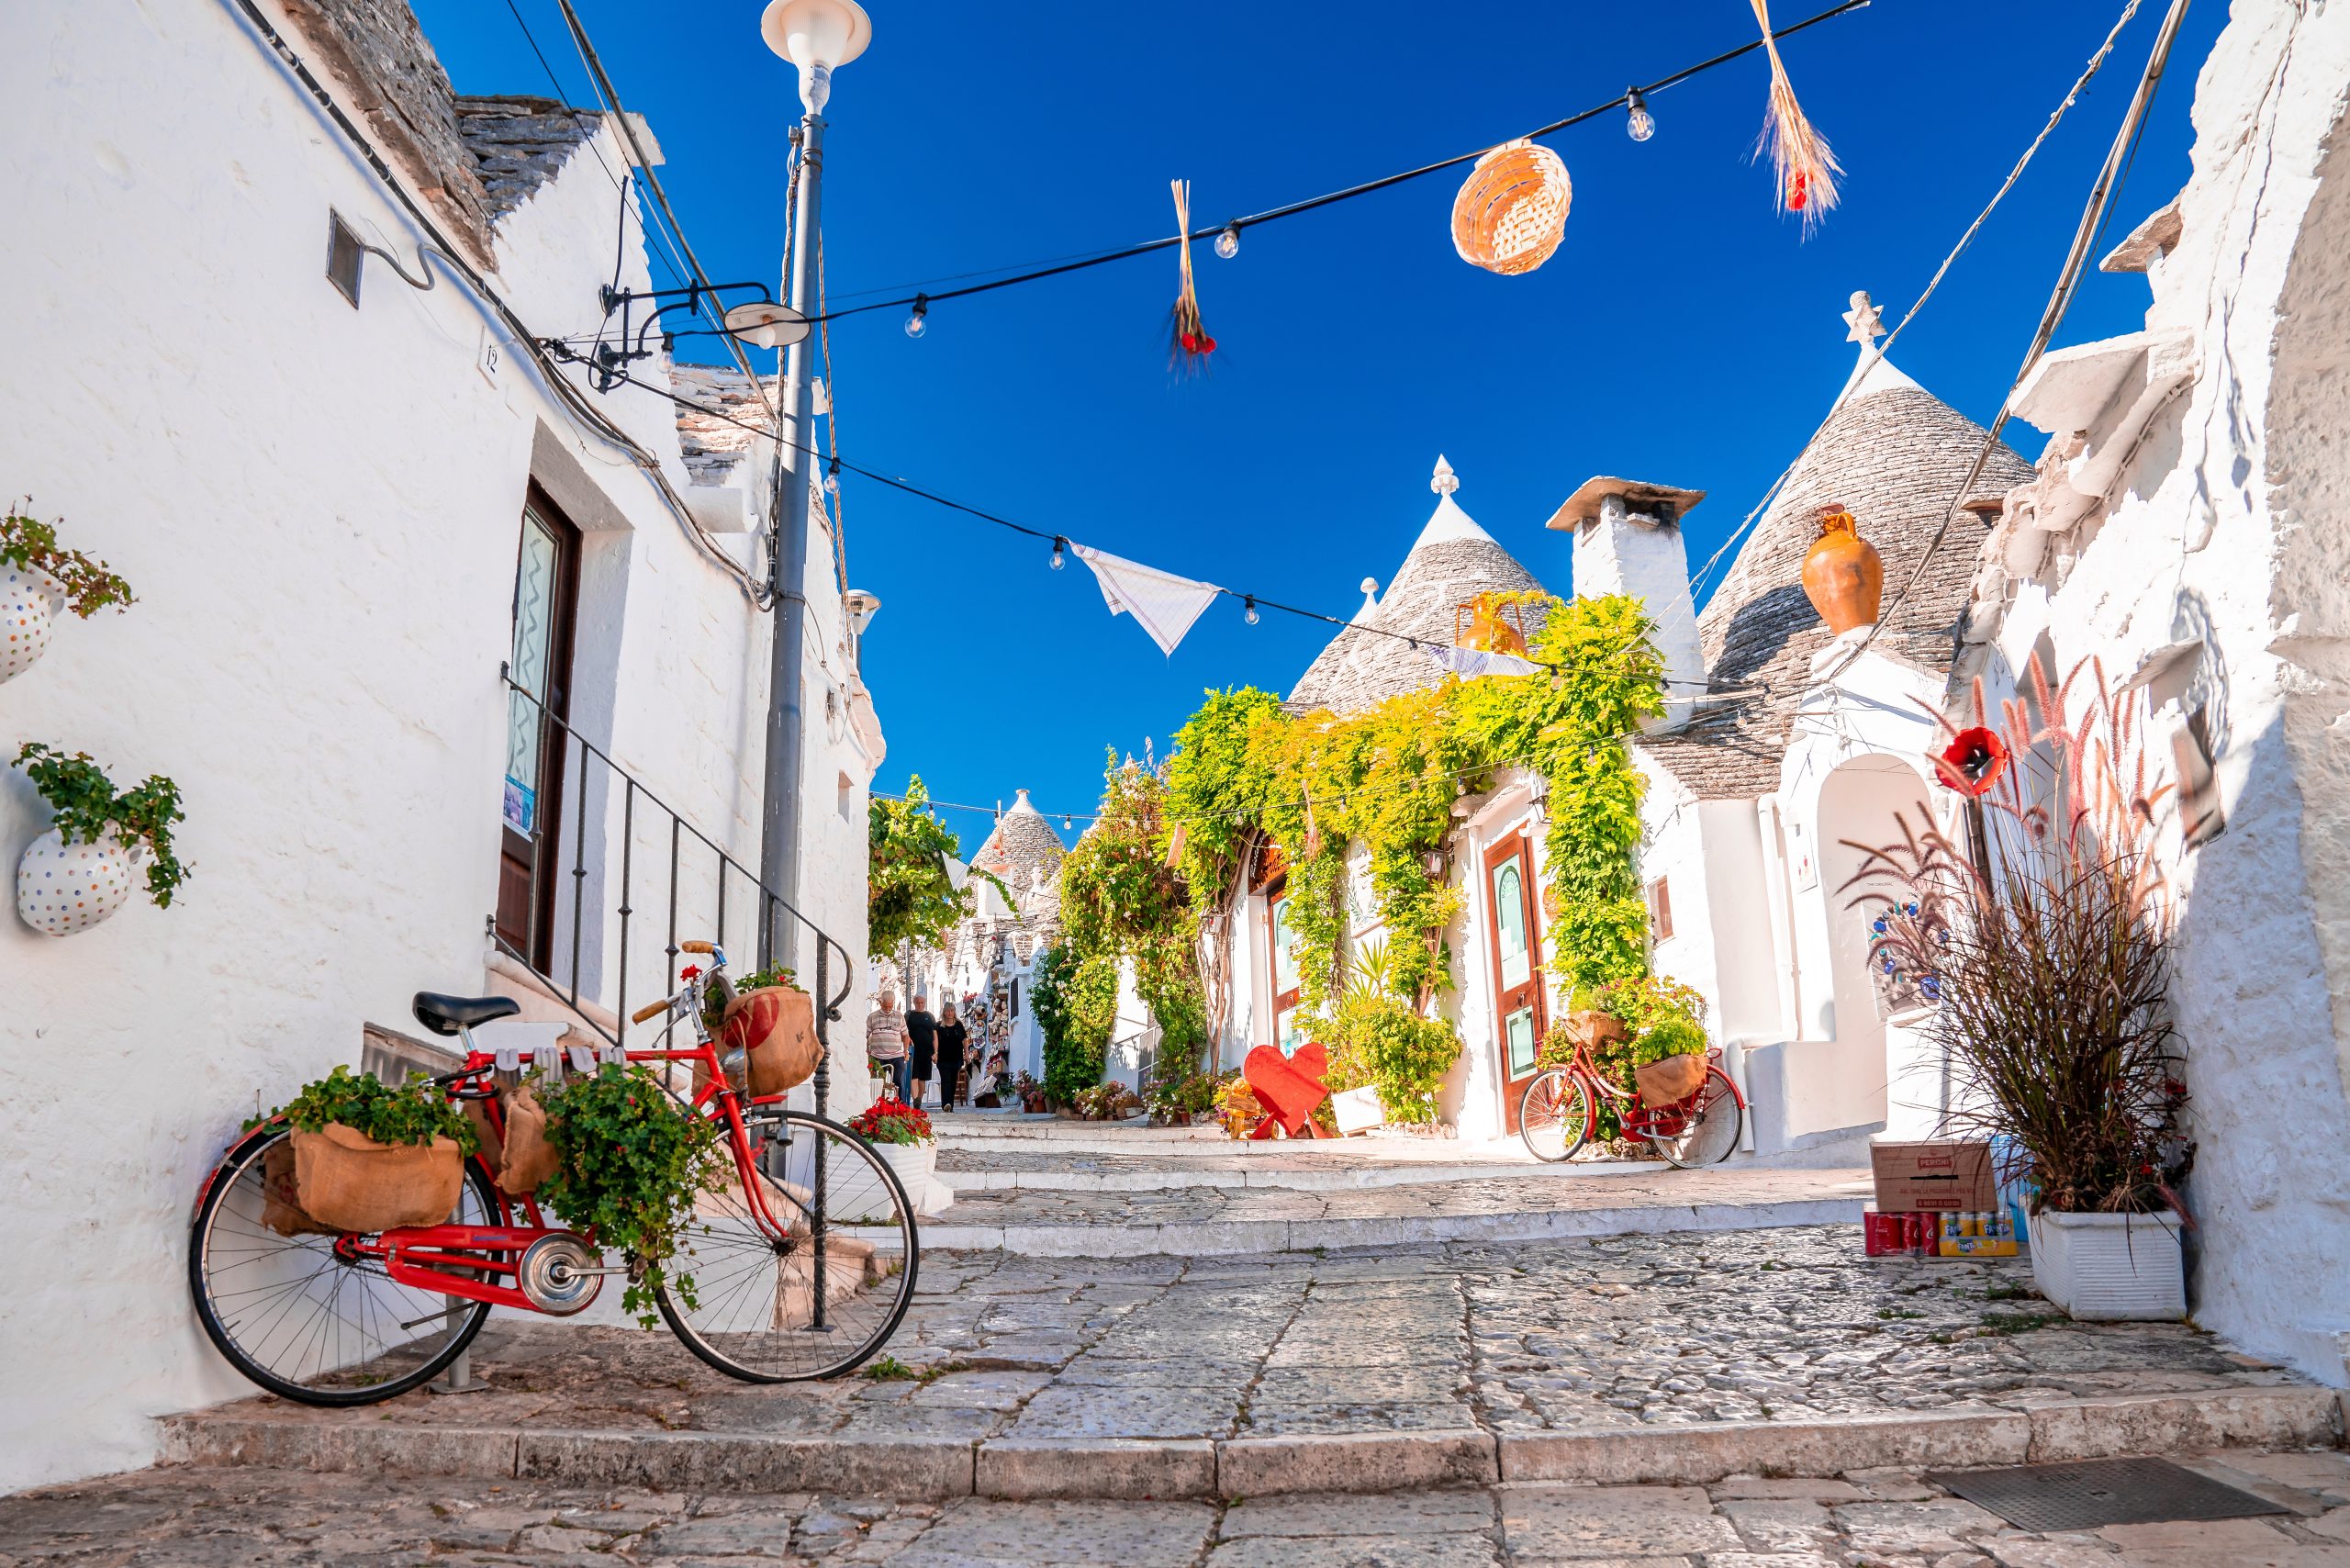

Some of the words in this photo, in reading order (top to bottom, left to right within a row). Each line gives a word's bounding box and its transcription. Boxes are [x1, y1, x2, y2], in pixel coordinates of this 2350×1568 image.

[486, 344, 498, 375] 12
[1919, 1159, 1950, 1167] PERONI
[1957, 1242, 1976, 1250] FANTA
